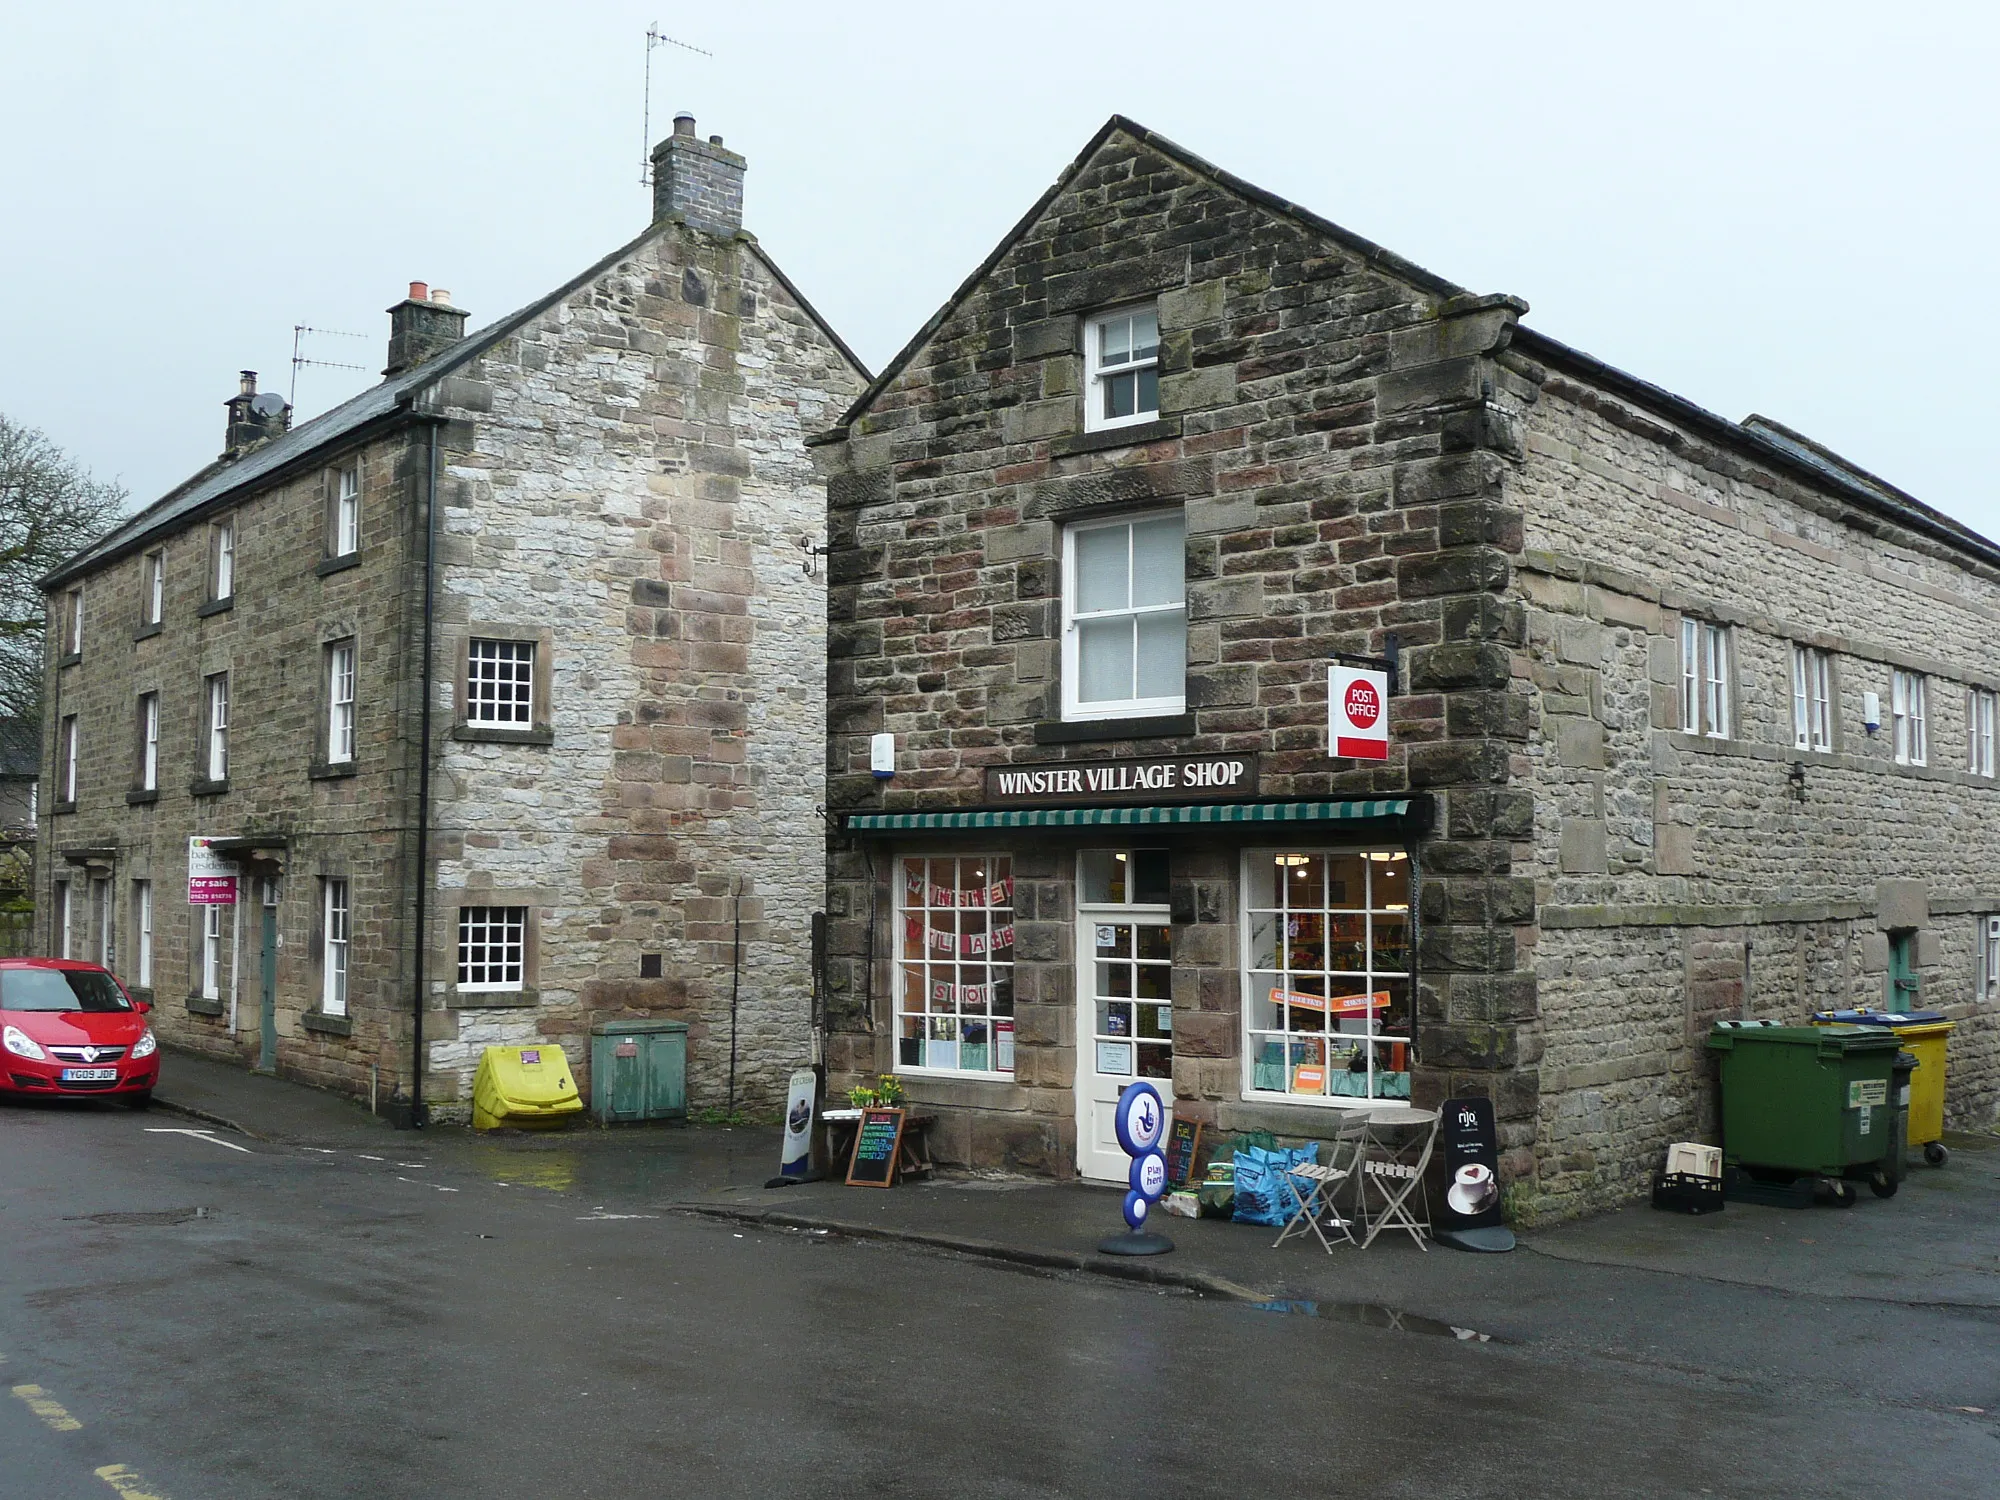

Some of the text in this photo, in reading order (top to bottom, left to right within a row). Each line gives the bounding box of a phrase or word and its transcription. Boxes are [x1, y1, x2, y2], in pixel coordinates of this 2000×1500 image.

[1352, 688, 1373, 703] POST
[1347, 702, 1376, 717] OFFICE
[998, 761, 1244, 795] WINSTER VILLAGE SHOP
[190, 878, 229, 888] for sale
[70, 1070, 115, 1079] YG09 JDF
[1146, 1175, 1162, 1186] here
